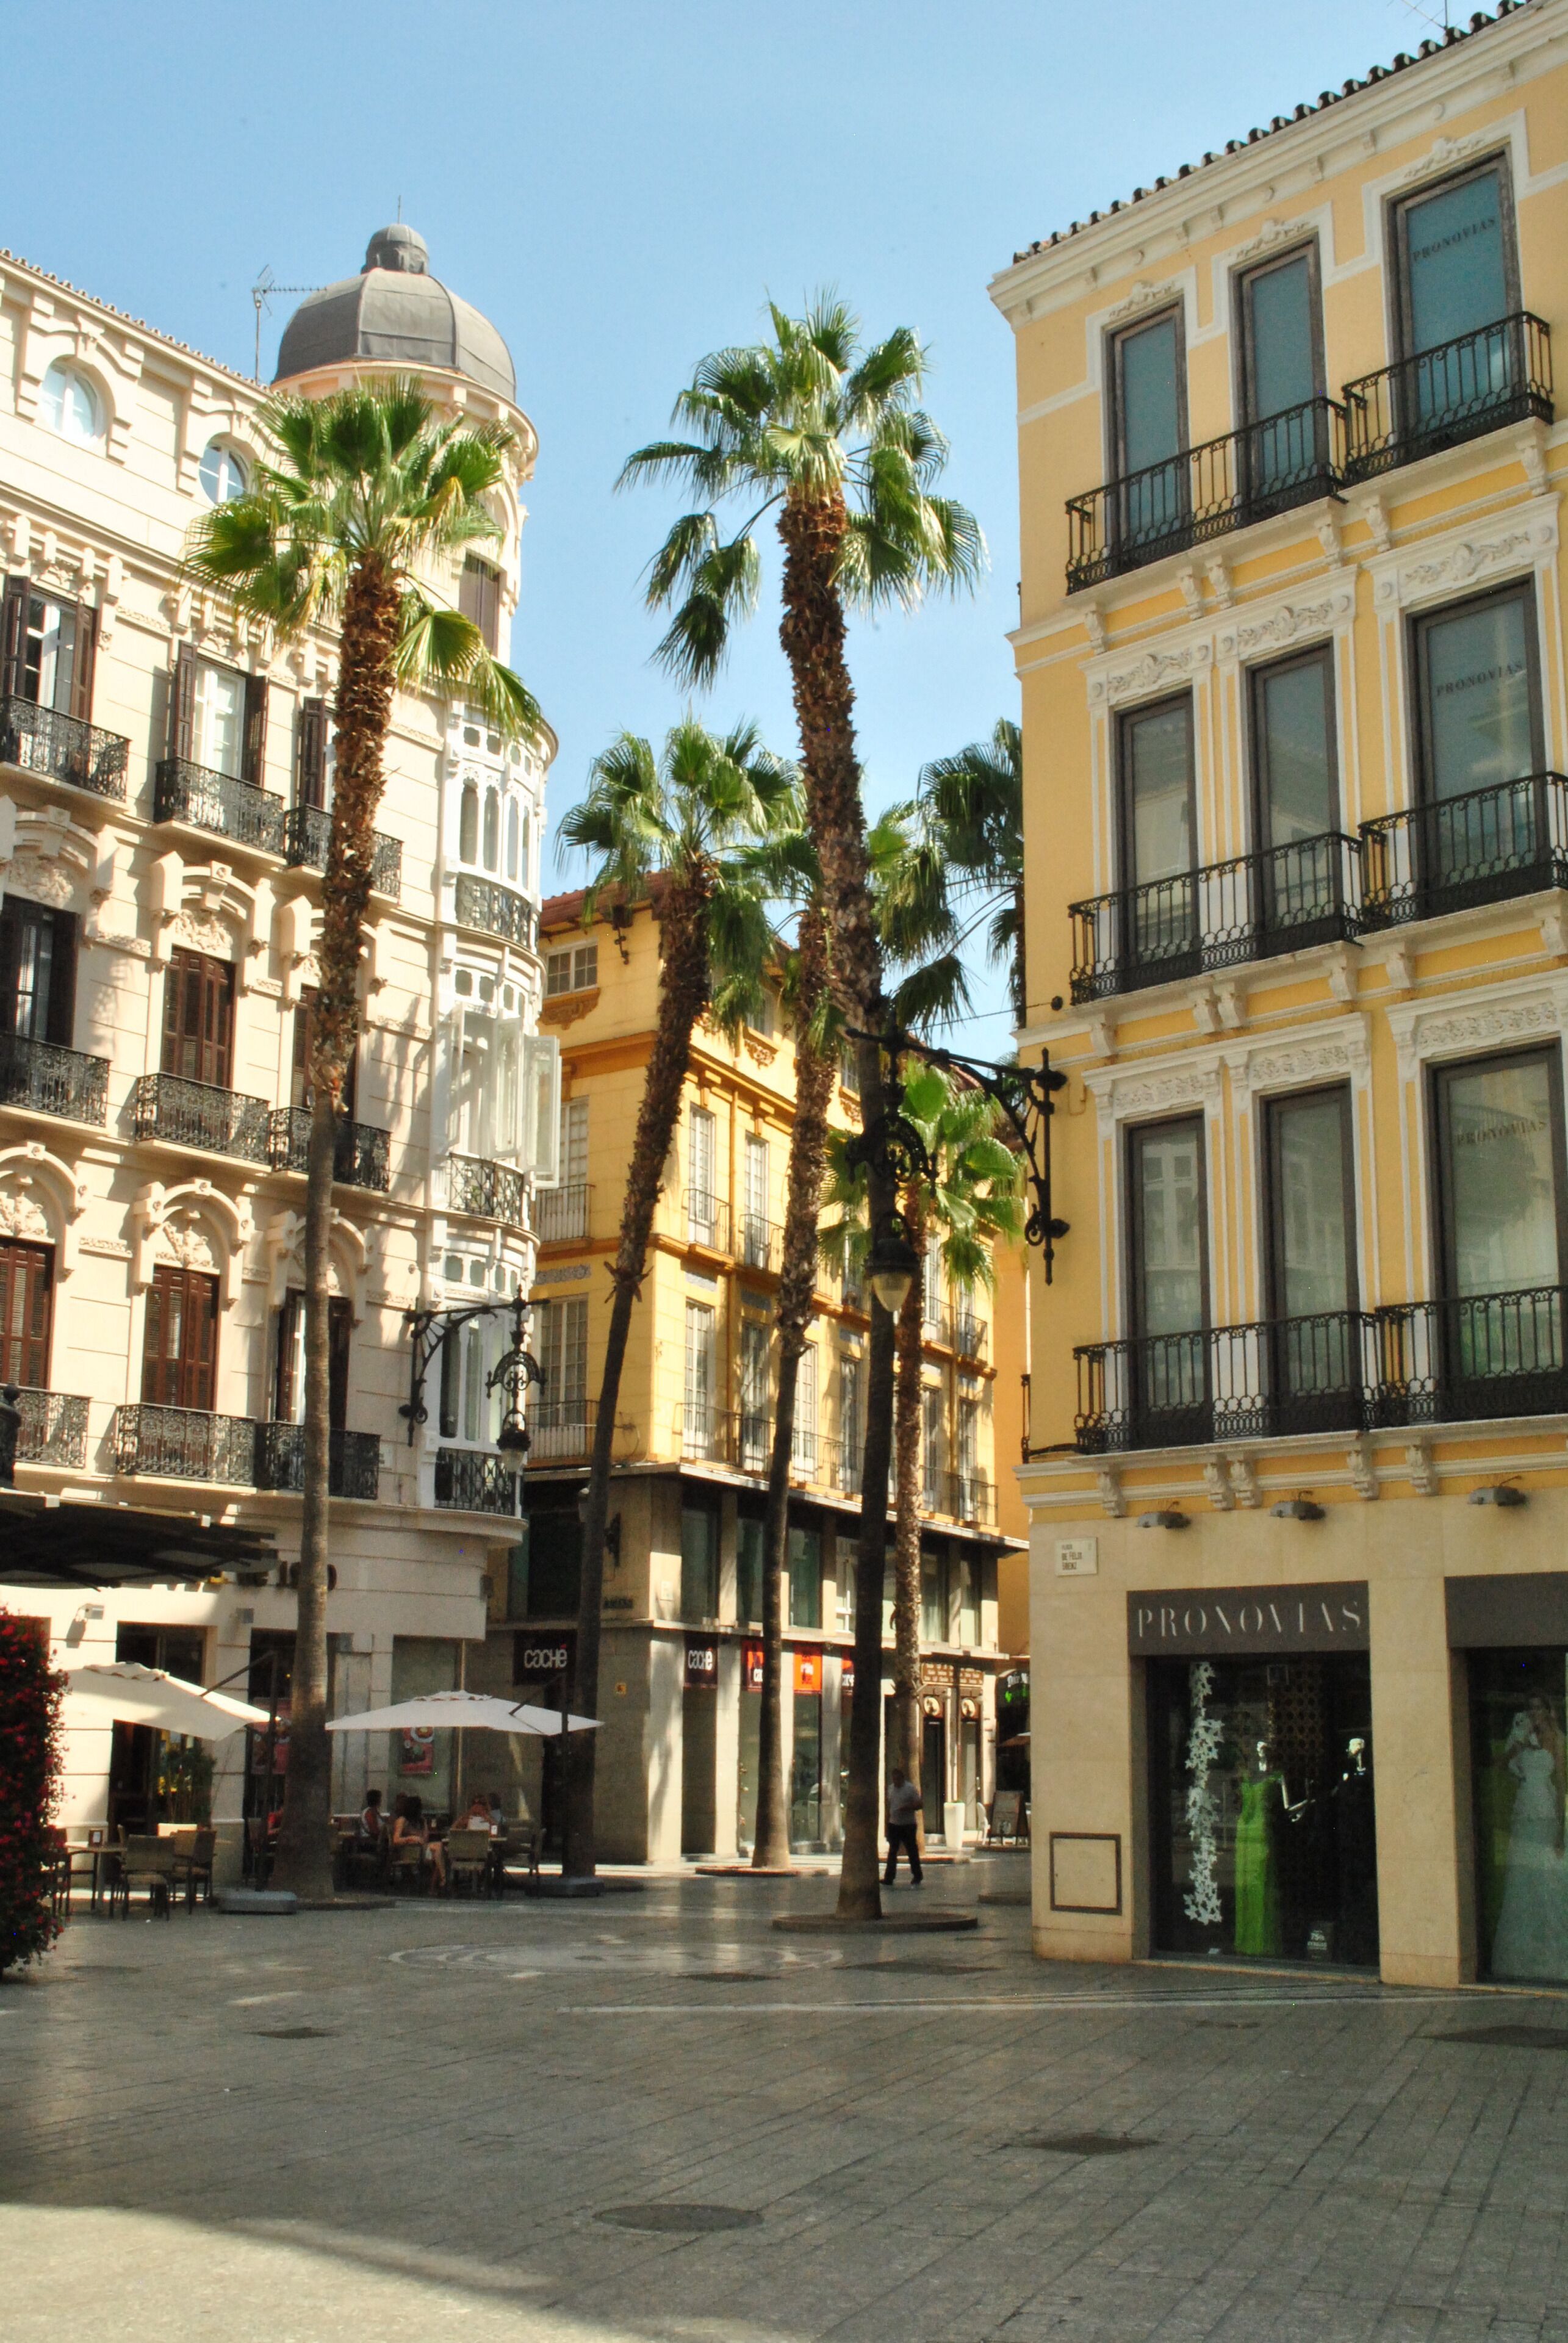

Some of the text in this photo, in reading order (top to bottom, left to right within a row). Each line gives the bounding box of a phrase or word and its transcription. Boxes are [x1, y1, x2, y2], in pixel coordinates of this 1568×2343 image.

[1412, 217, 1495, 262] PRONOVIAS
[1436, 661, 1523, 696] PRONOVIAS
[1138, 1601, 1361, 1638] PRONOVIAS
